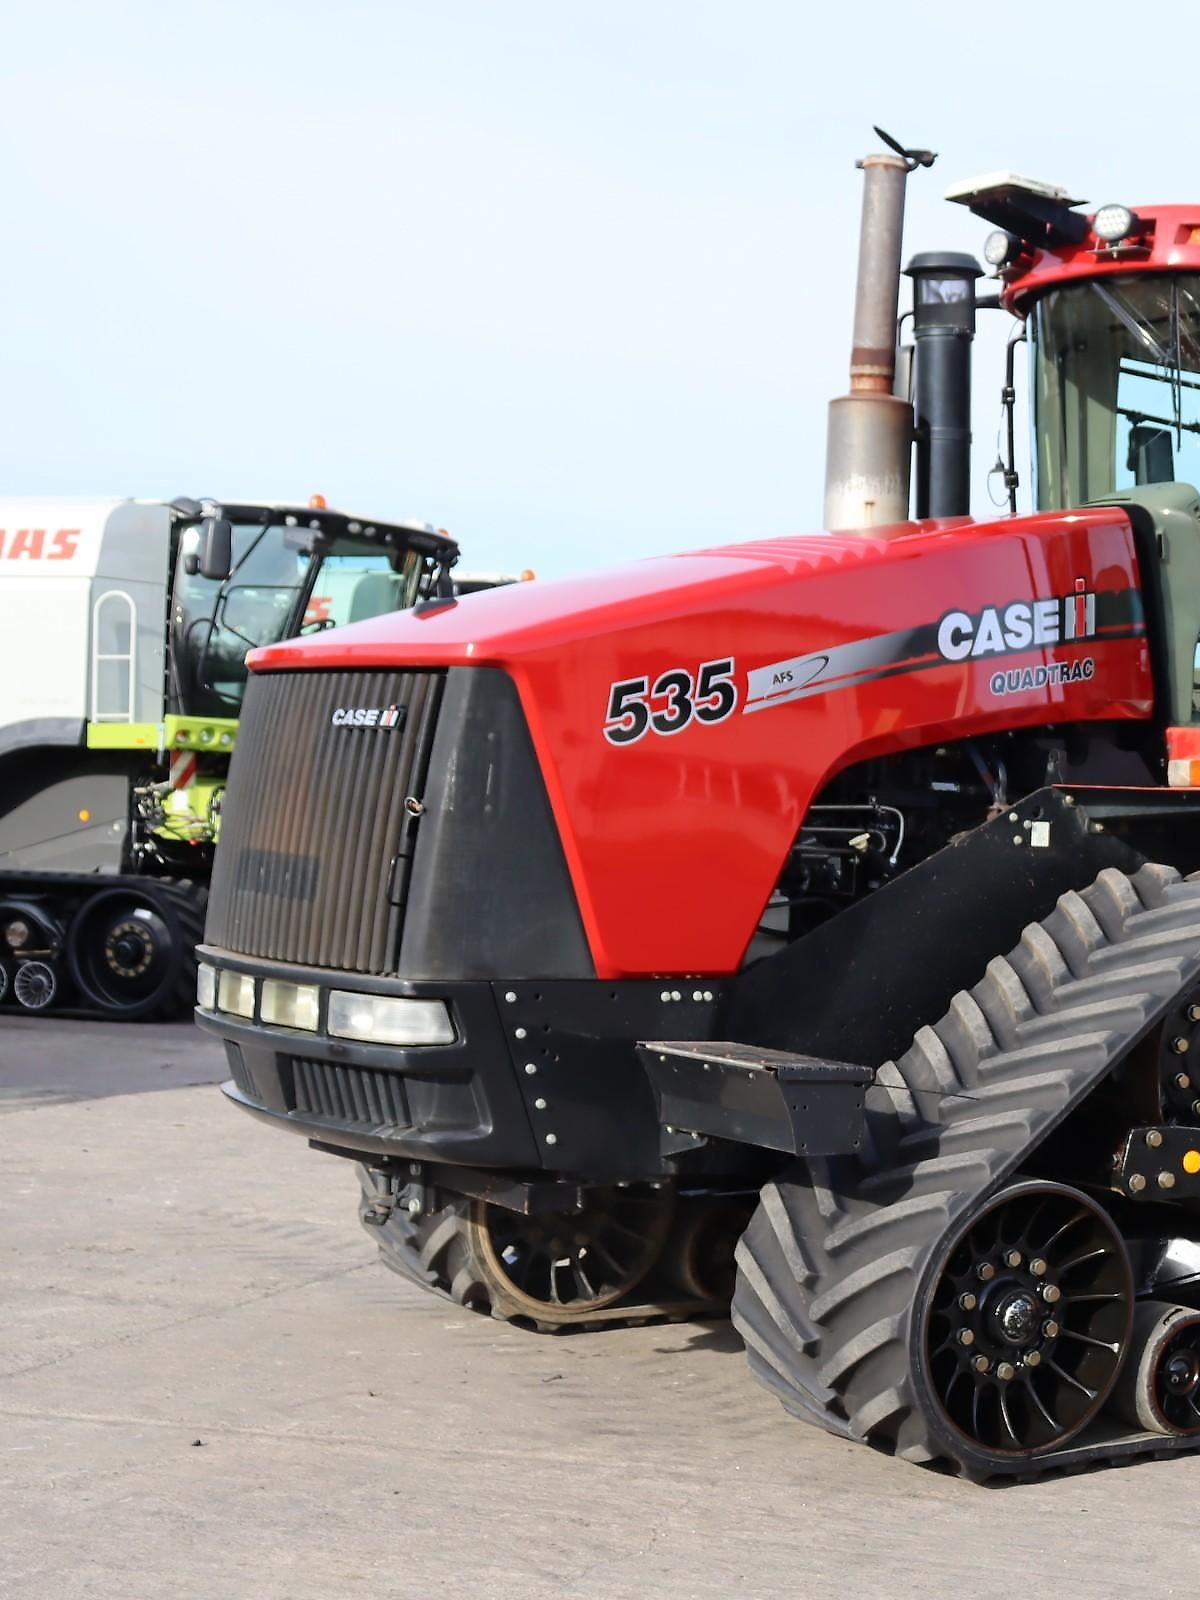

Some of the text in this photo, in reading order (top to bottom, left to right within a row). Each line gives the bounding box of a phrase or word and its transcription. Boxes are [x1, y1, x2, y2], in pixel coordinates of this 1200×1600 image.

[0, 528, 82, 560] AS
[937, 599, 1060, 661] CASE
[772, 670, 794, 686] AFS
[989, 656, 1095, 696] QUADTRAC
[331, 708, 380, 727] CASE
[602, 656, 738, 746] 535
